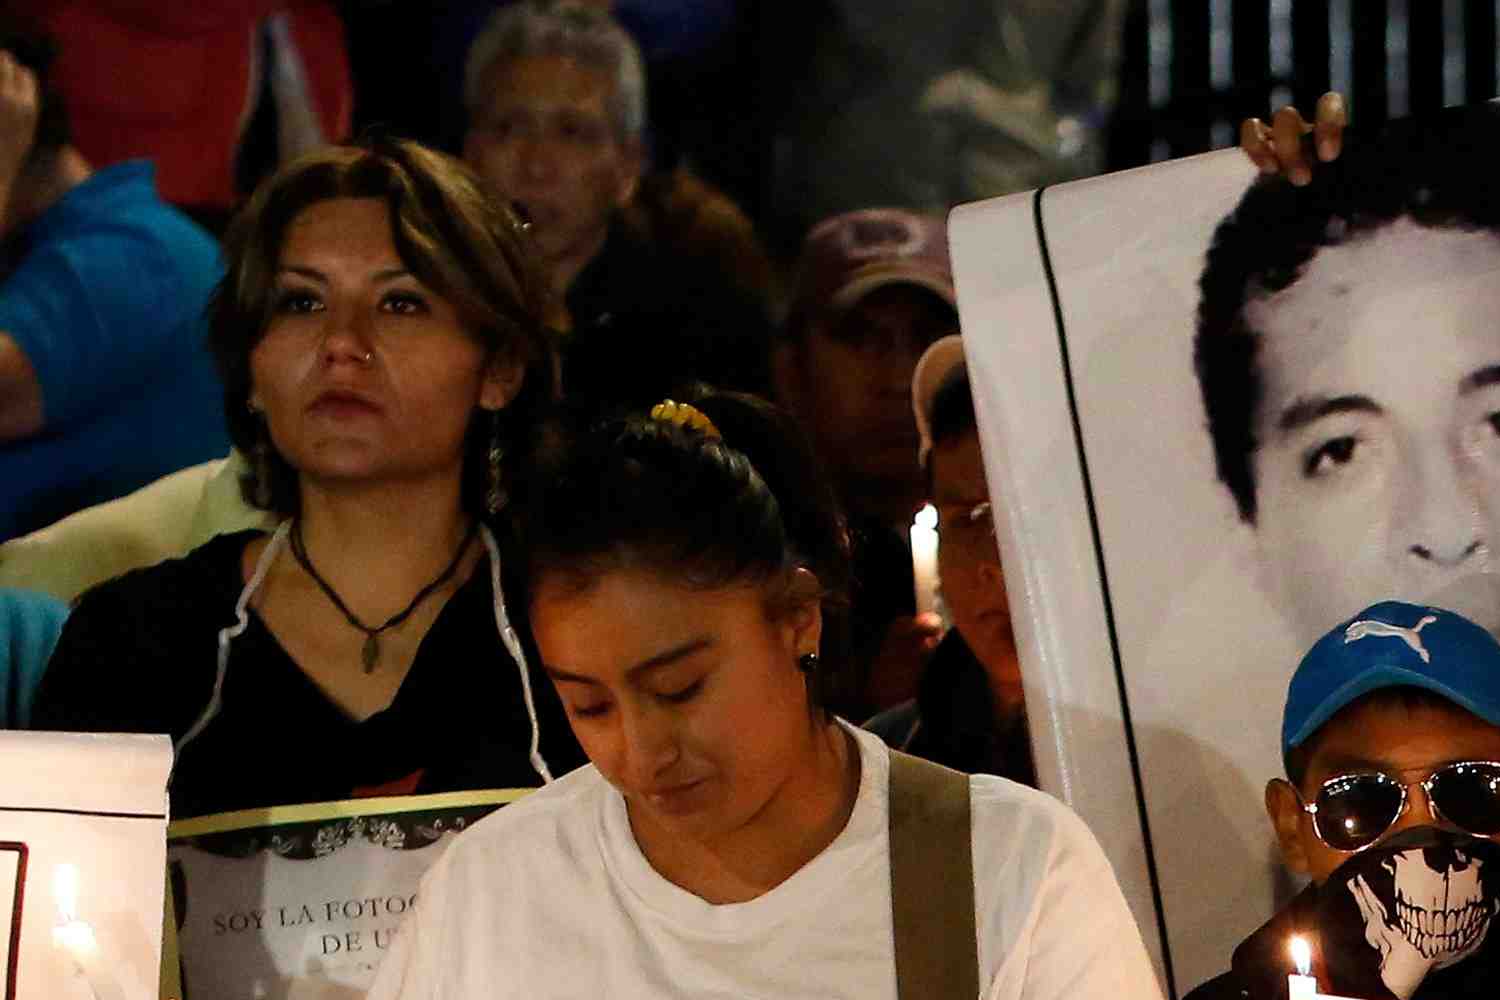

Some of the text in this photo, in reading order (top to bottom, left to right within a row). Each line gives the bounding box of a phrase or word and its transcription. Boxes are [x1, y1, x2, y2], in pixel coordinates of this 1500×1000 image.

[213, 910, 265, 937] SOY
[279, 904, 315, 927] LA
[321, 930, 363, 955] DE
